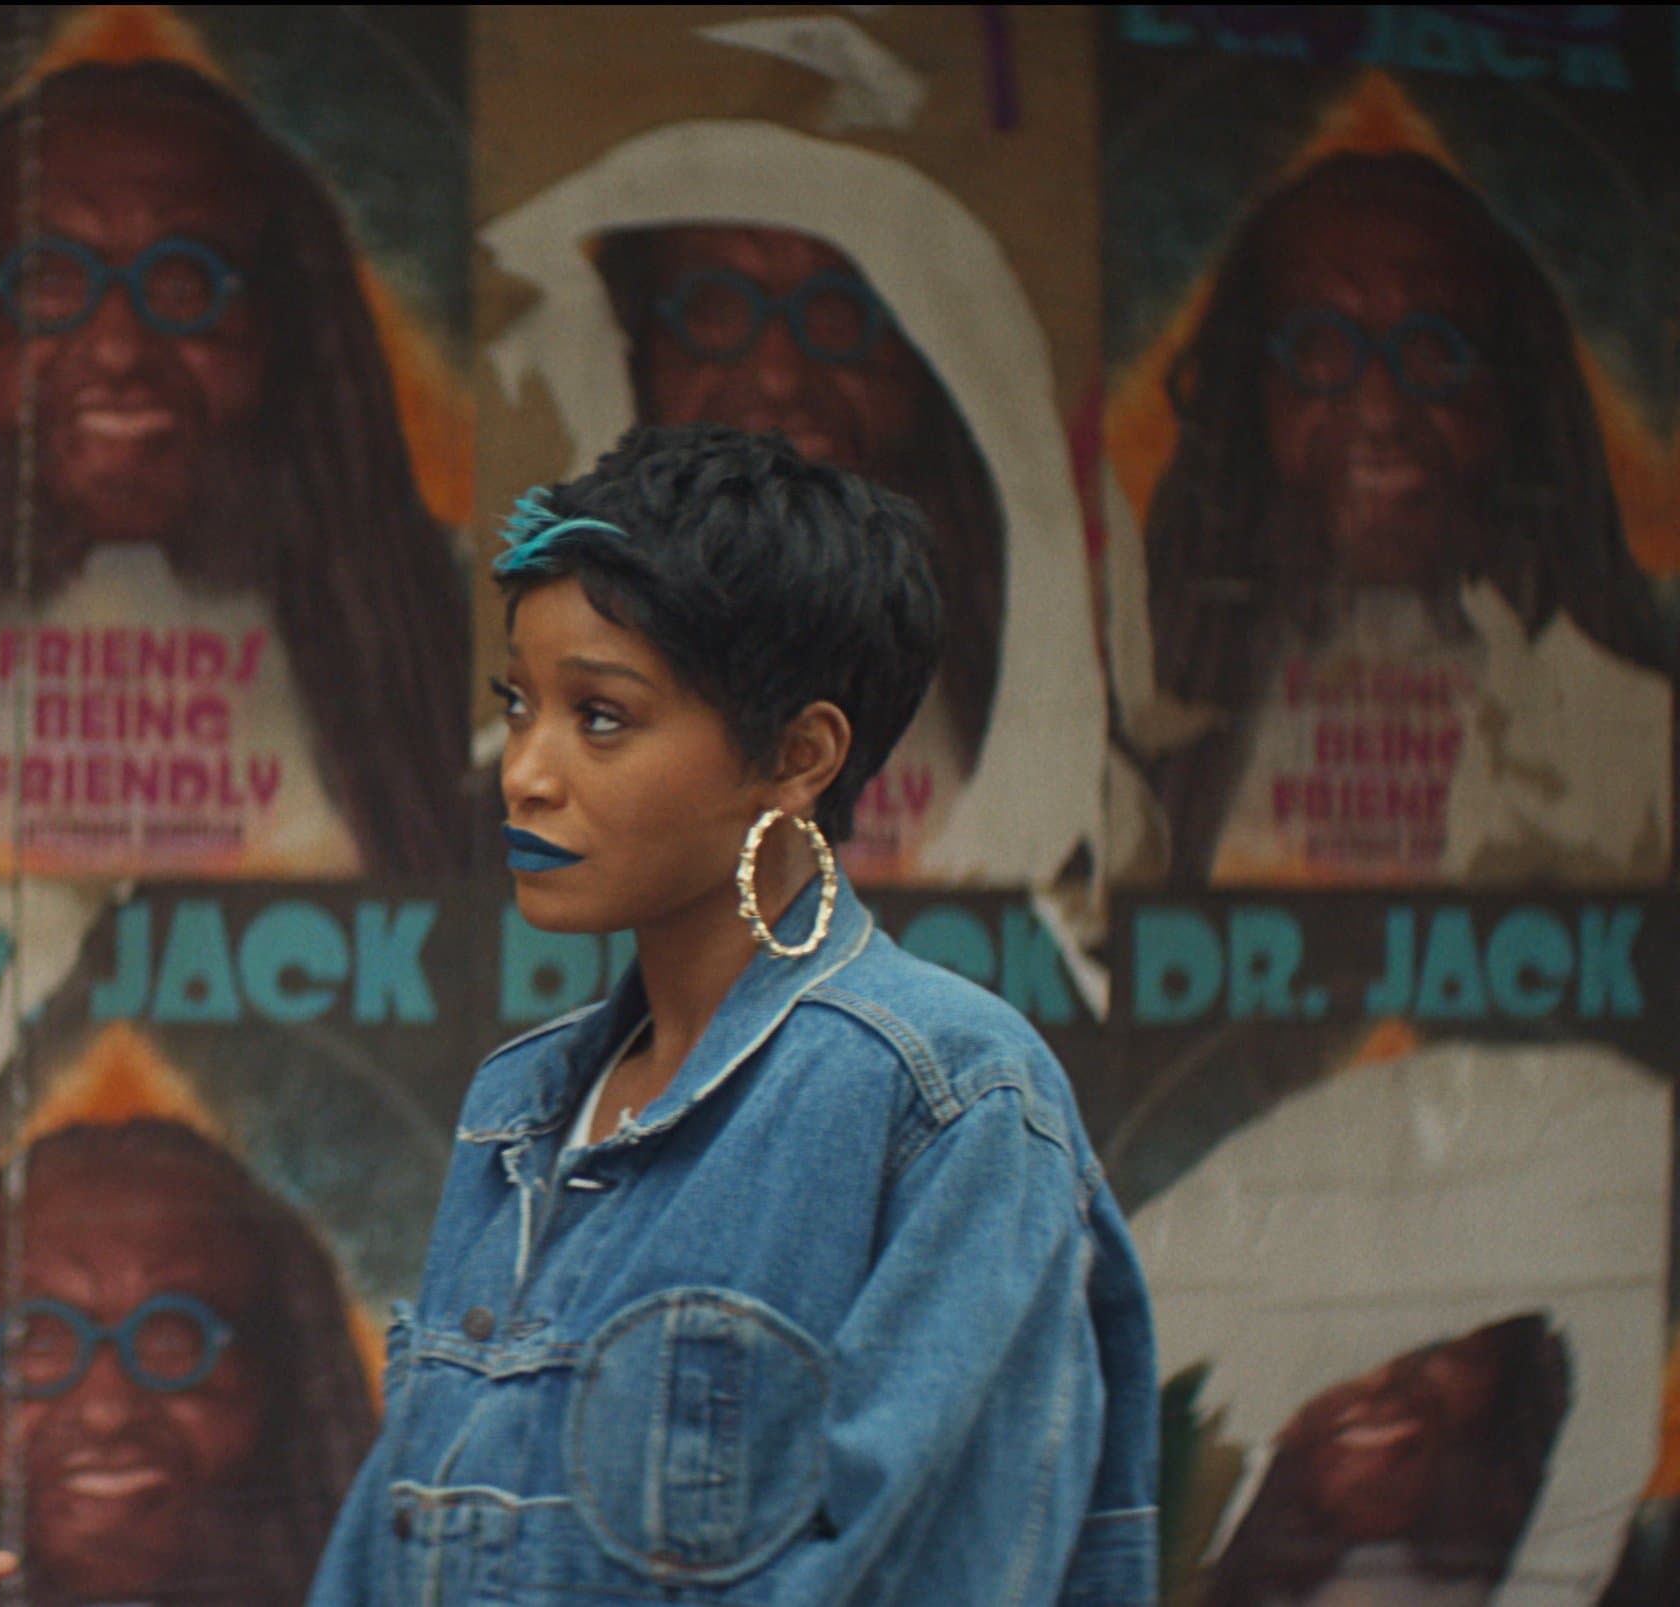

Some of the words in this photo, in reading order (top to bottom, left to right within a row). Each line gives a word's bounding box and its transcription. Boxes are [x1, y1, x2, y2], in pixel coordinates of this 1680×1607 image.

[32, 690, 229, 744] BEING
[88, 897, 439, 1023] JACK
[1132, 904, 1329, 1025] DR.
[1364, 906, 1644, 1021] JACK
